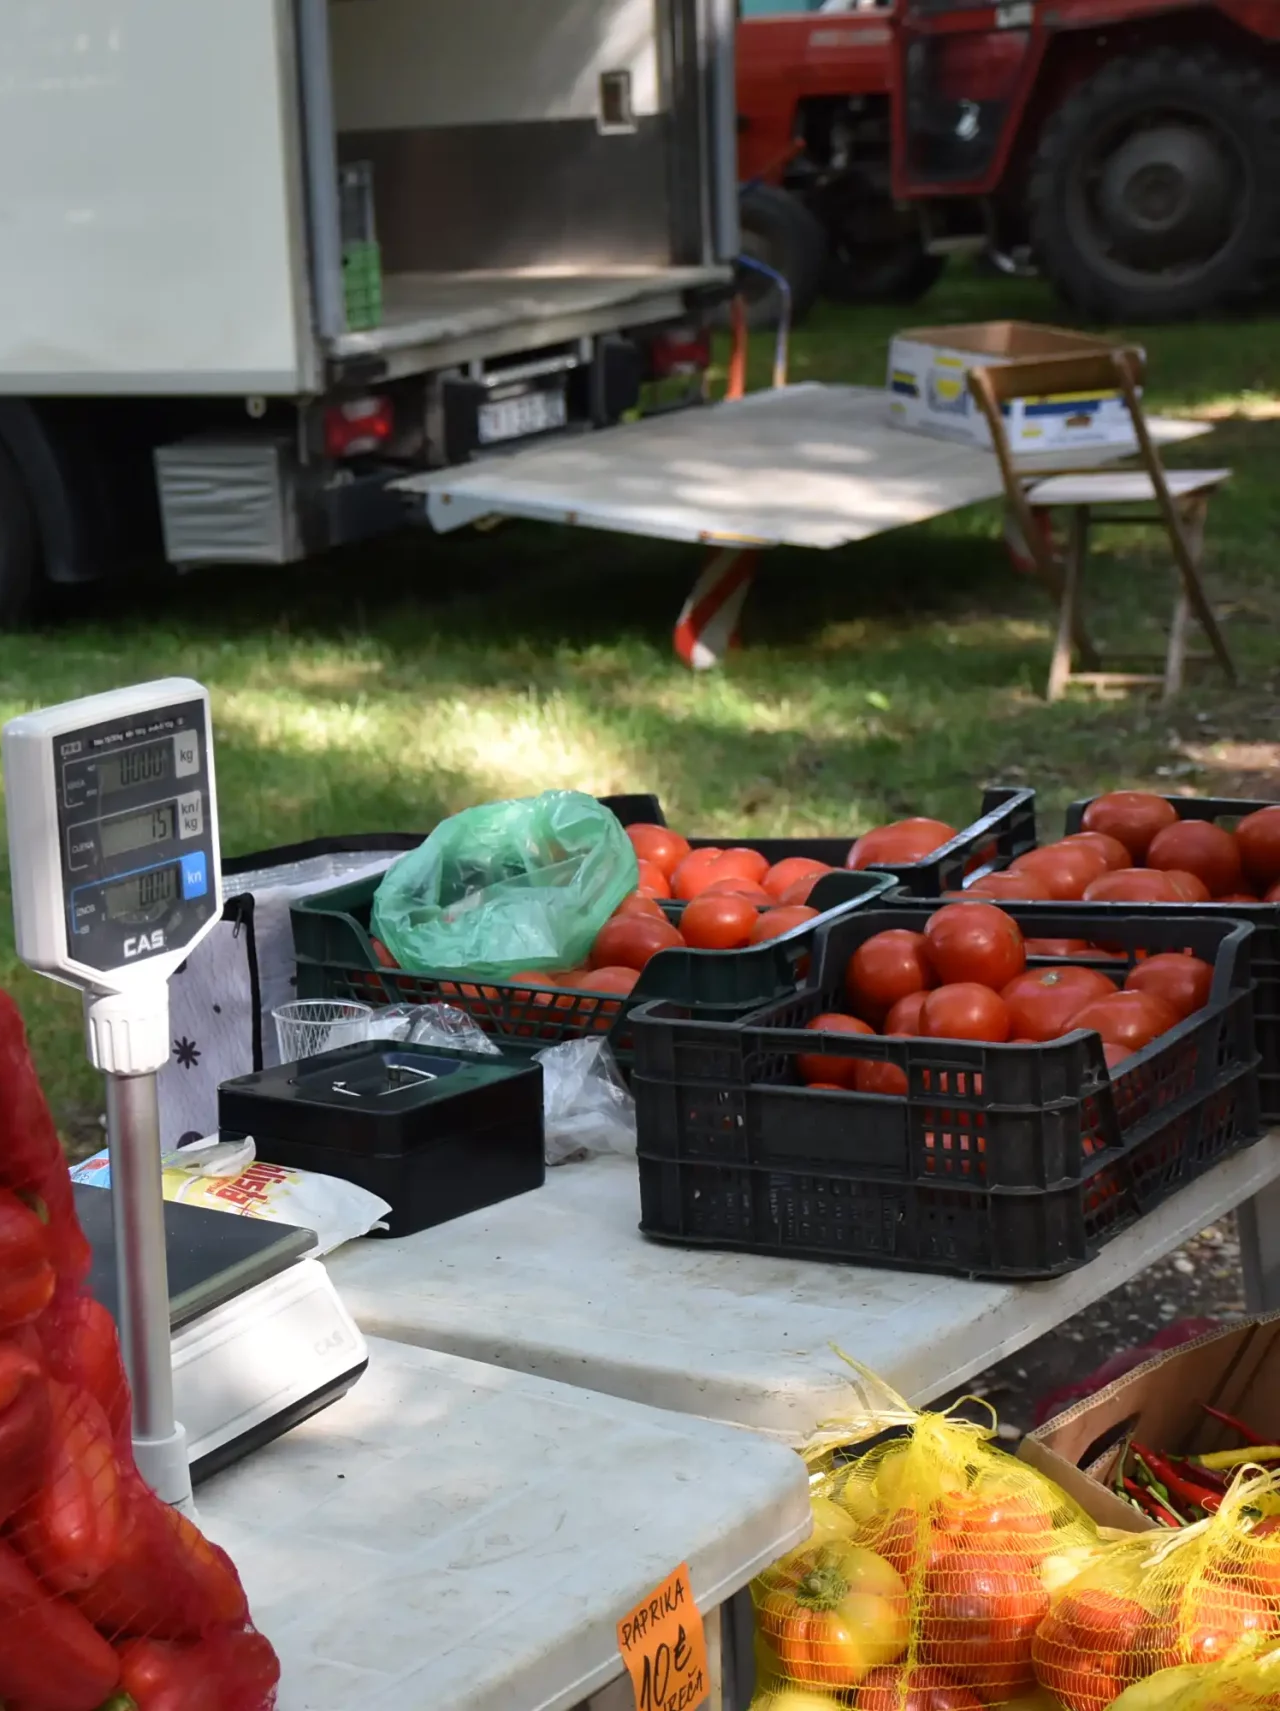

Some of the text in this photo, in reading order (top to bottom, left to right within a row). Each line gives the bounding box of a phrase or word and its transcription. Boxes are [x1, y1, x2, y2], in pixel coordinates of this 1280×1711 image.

[180, 748, 194, 764] kg
[181, 798, 200, 814] kn/
[184, 815, 198, 831] kg
[187, 869, 201, 884] kn
[123, 929, 164, 958] CAS
[622, 1577, 684, 1651] PAPRIKA
[664, 1665, 703, 1711] REČA
